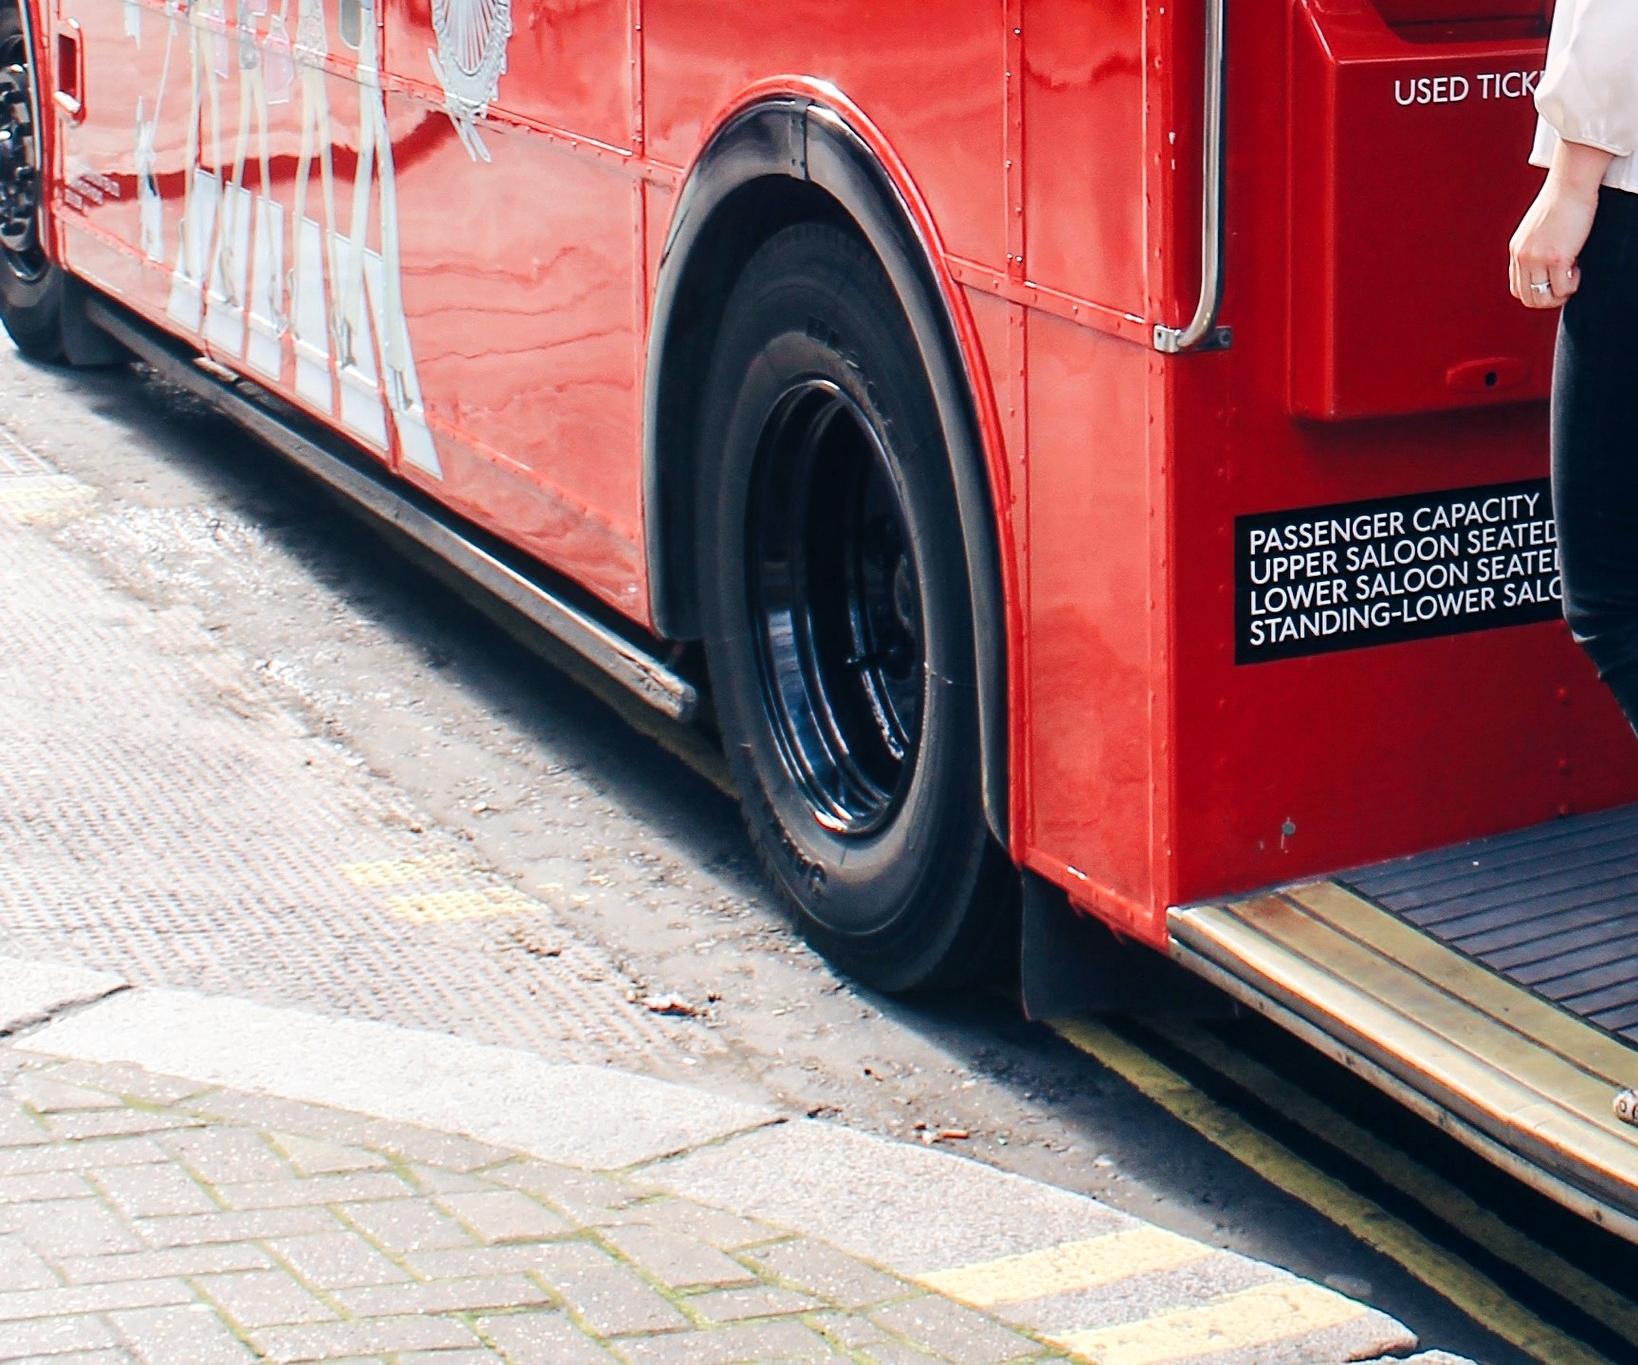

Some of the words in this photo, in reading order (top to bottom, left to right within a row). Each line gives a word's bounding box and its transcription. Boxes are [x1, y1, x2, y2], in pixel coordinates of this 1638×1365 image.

[1394, 74, 1470, 106] USED
[1249, 511, 1405, 556] PASSENGER
[1412, 492, 1541, 533] CAPACITY
[1249, 549, 1338, 585] UPPER
[1345, 533, 1460, 572] SALOON
[1250, 579, 1348, 616] LOWER
[1355, 561, 1469, 602] SALOON
[1249, 587, 1496, 647] STANDING-LOWER
